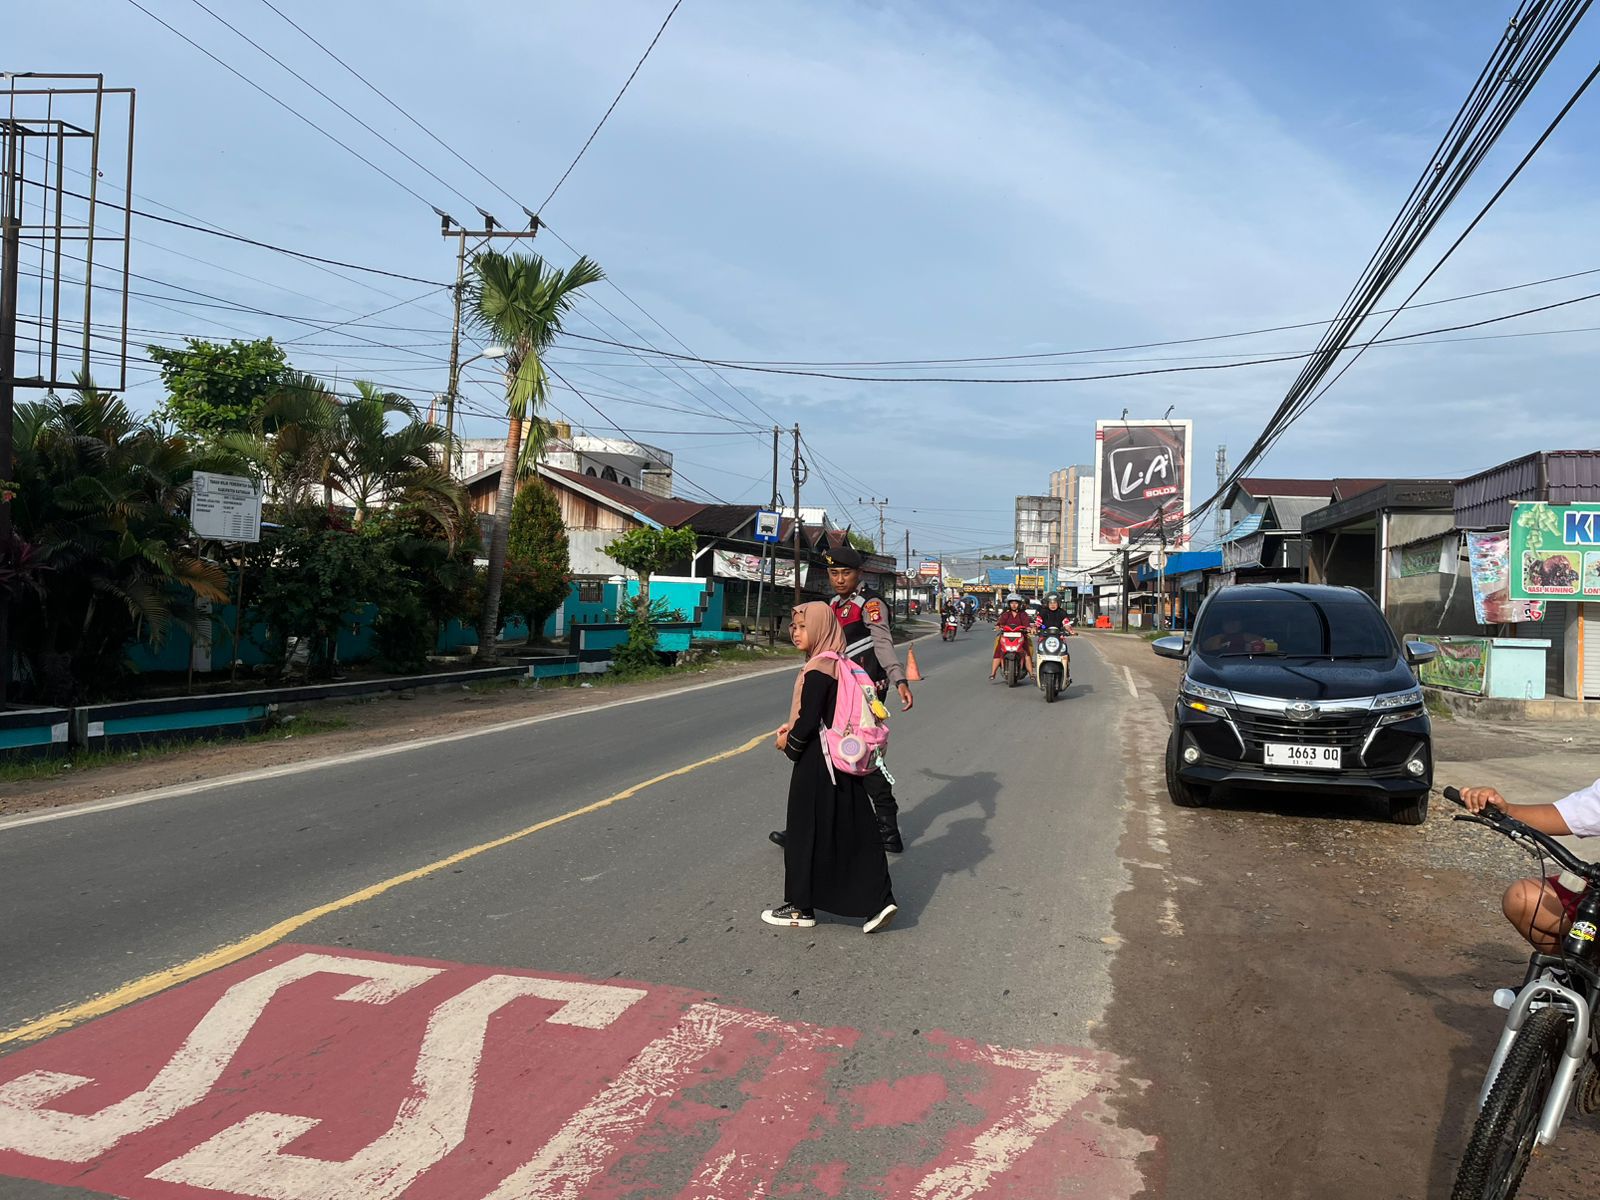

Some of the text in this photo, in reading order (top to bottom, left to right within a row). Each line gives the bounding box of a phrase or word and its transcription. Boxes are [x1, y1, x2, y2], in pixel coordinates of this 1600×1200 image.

[1544, 586, 1574, 595] KUNING
[1267, 745, 1274, 757] L
[1287, 746, 1317, 760] 1663
